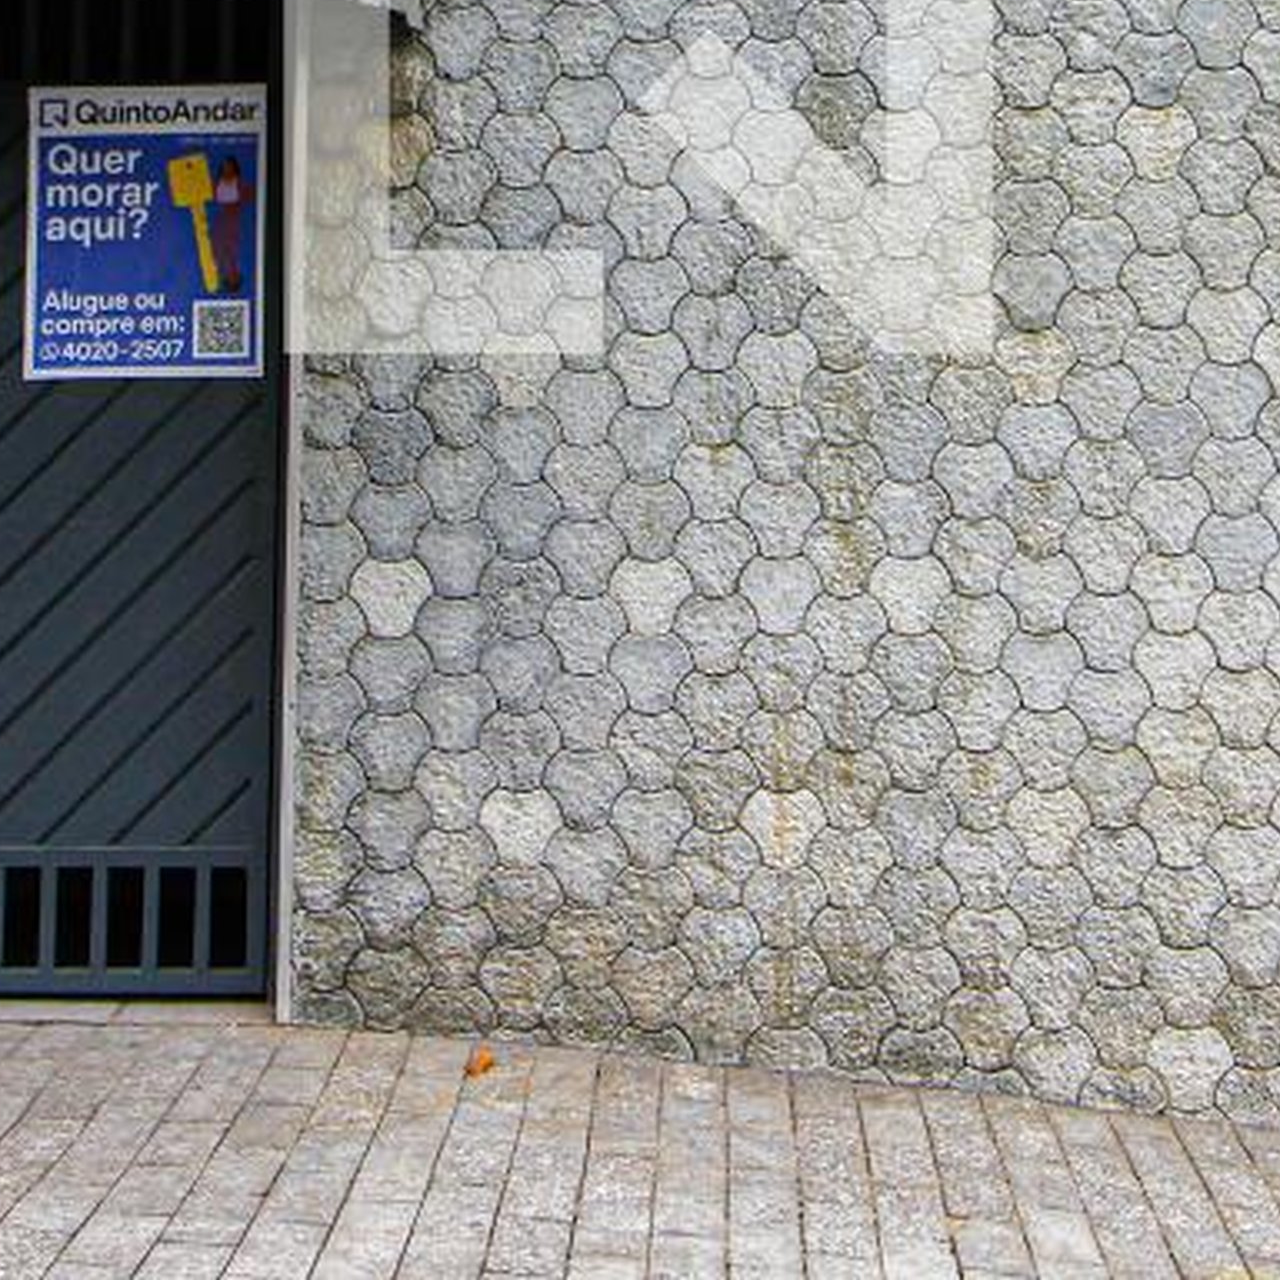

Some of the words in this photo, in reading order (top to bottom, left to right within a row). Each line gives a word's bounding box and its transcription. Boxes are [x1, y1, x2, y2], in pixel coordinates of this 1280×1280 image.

[75, 99, 259, 125] QuintoAndar
[48, 143, 143, 175] Quer
[46, 182, 159, 208] morar
[46, 208, 149, 248] aqui?
[42, 291, 129, 317] Alugue
[133, 294, 165, 310] ou
[41, 317, 135, 337] compre
[140, 316, 185, 334] em:
